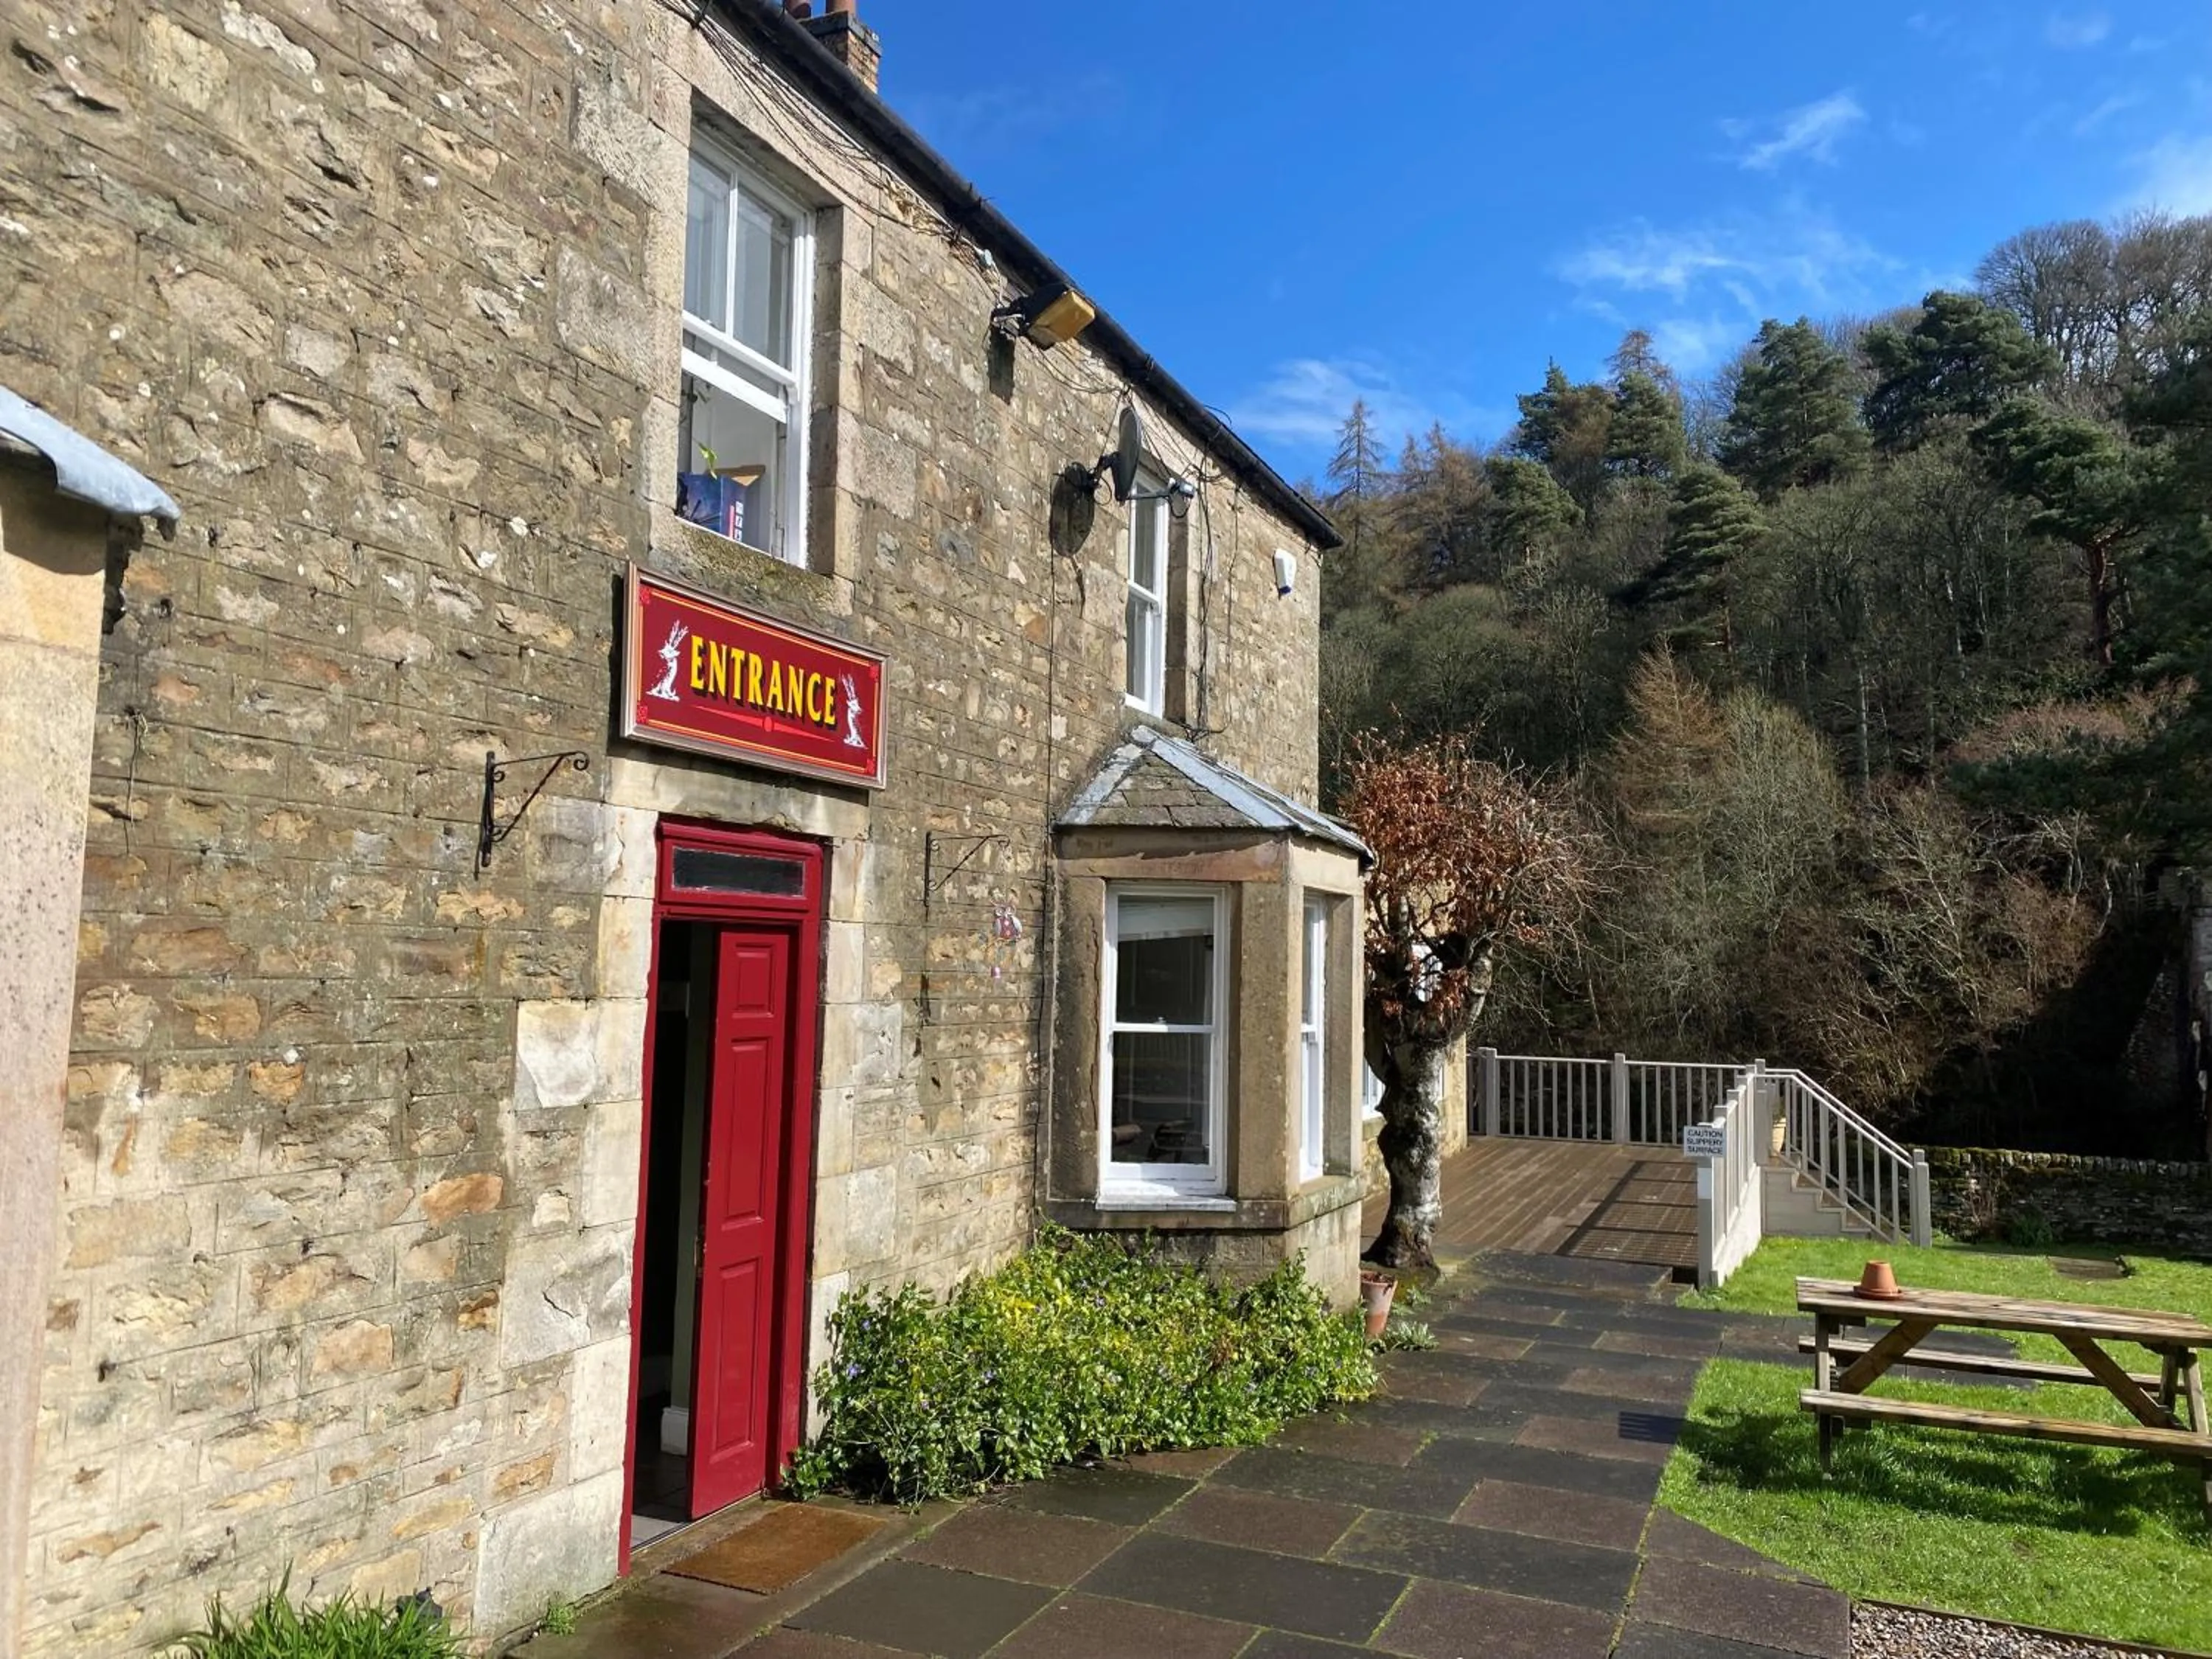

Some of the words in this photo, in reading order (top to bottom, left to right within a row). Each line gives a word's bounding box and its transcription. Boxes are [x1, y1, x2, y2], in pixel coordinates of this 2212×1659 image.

[689, 635, 836, 726] ENTRANCE
[1688, 1129, 1722, 1138] CAUTION
[1687, 1138, 1722, 1146] SLIPPERY
[1688, 1146, 1723, 1155] SURFACE
